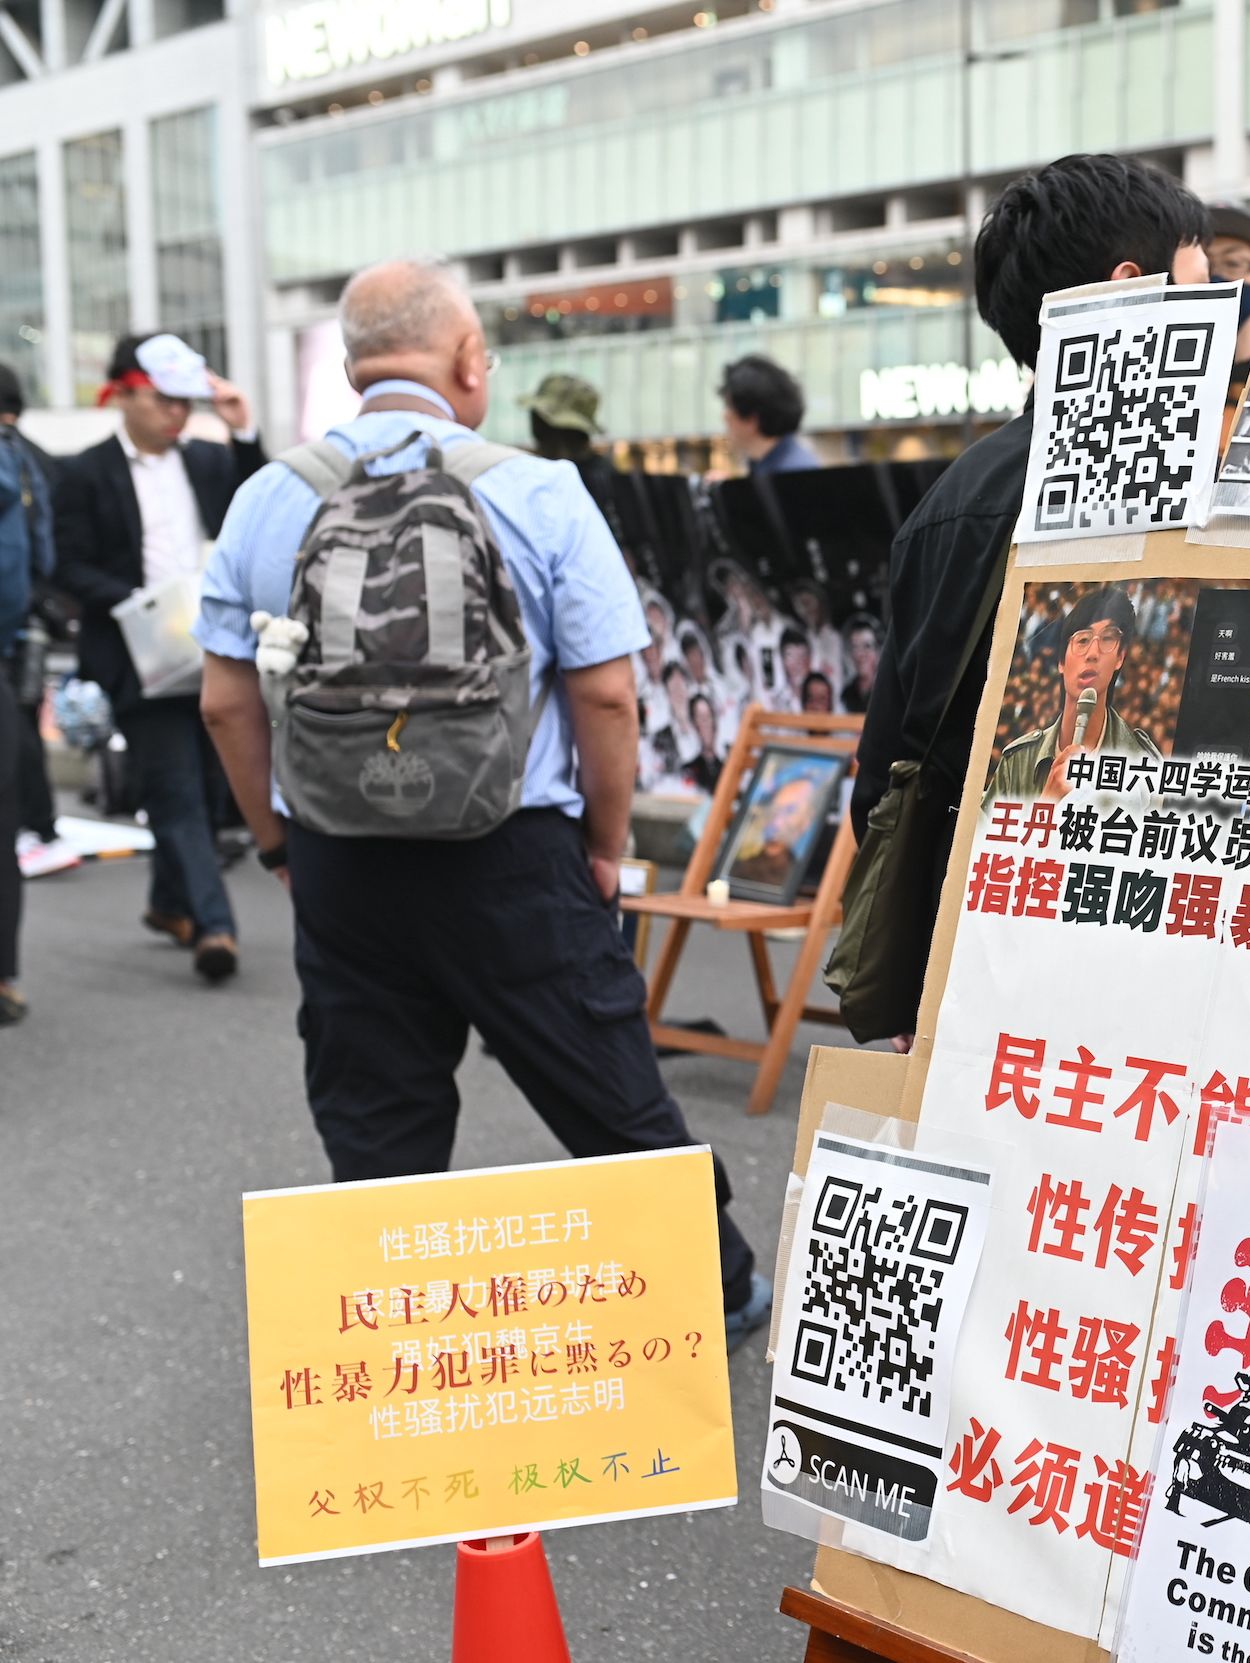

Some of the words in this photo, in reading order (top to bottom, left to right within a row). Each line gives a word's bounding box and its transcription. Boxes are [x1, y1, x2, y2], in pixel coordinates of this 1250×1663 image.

[378, 1207, 592, 1264] 性骚扰犯王丹
[338, 1270, 648, 1334] 民主人権のため
[368, 1377, 626, 1441] 性骚扰犯远志明
[308, 1469, 480, 1518] 父权不死
[508, 1447, 681, 1496] 极权不止
[807, 1455, 869, 1503] SCAN
[874, 1472, 916, 1520] ME
[1176, 1540, 1236, 1585] The
[1187, 1621, 1215, 1655] is
